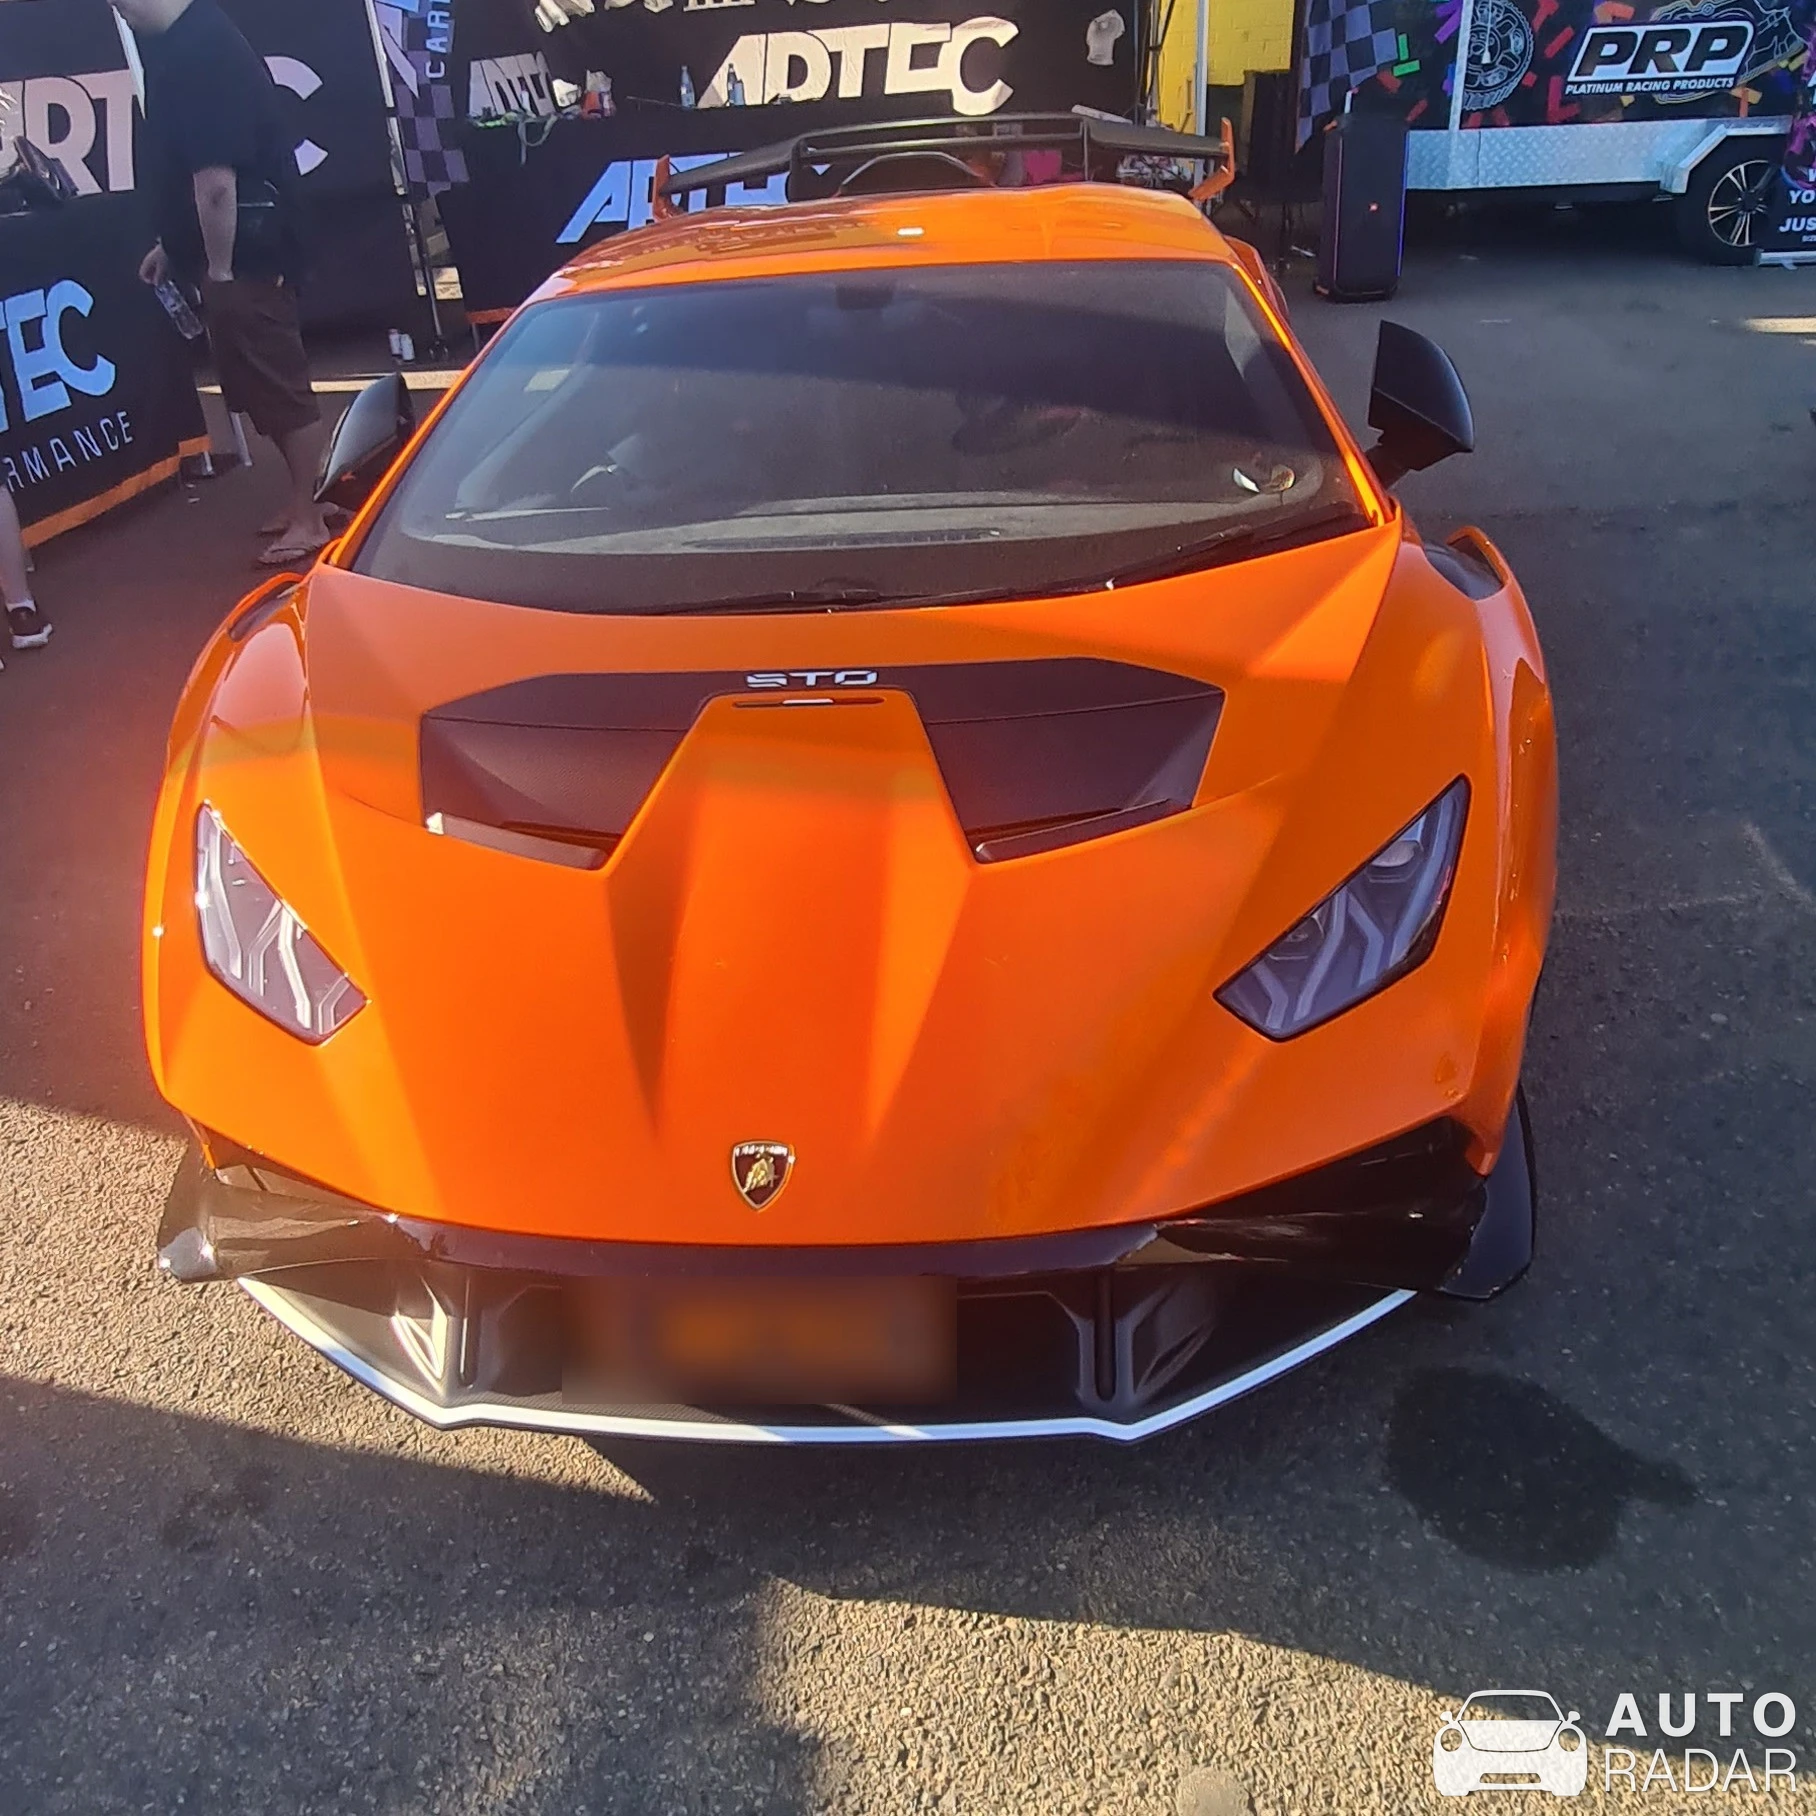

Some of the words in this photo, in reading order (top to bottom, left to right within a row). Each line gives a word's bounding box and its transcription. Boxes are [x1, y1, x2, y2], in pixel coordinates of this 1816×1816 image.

[425, 0, 451, 78] CAR
[1575, 26, 1749, 77] PRP
[1565, 82, 1623, 95] PLATINUM
[1626, 79, 1670, 92] RACING
[1673, 77, 1735, 90] PRODUCTS
[747, 670, 878, 688] STO
